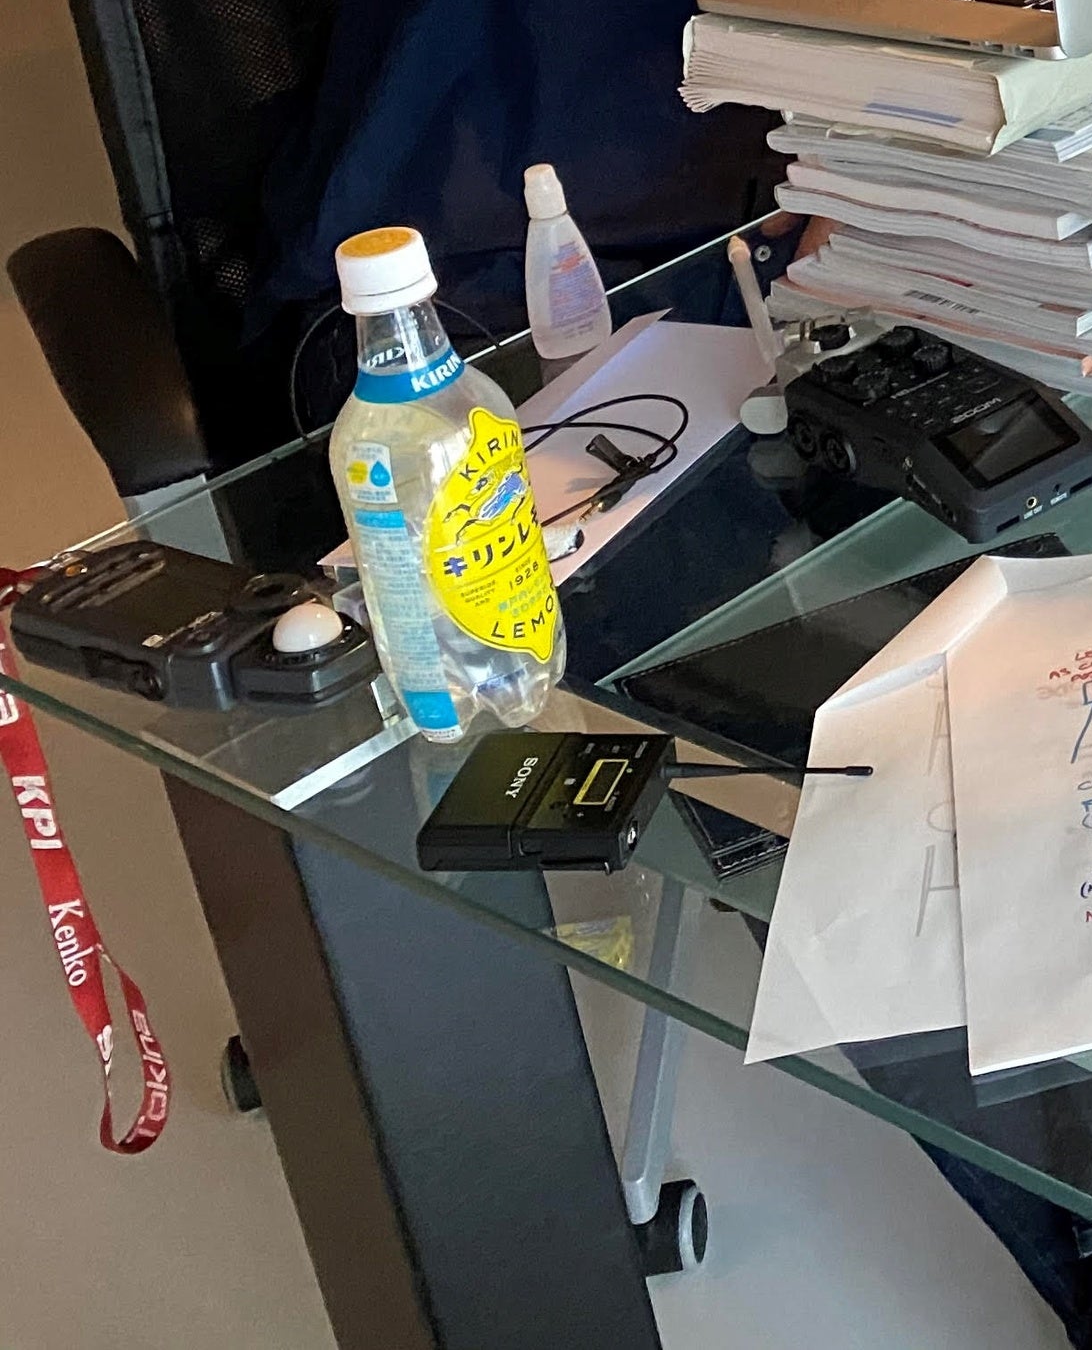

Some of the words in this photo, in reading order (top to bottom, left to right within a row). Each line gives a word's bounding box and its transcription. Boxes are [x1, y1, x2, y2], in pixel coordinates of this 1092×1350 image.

[411, 350, 462, 393] KIRIN
[459, 429, 519, 482] KIRIN
[509, 561, 539, 591] 1928
[1049, 667, 1071, 680] AS
[505, 757, 539, 798] SONY
[12, 775, 64, 850] KPI
[49, 899, 95, 987] Kenko
[126, 1009, 168, 1143] Tokina
